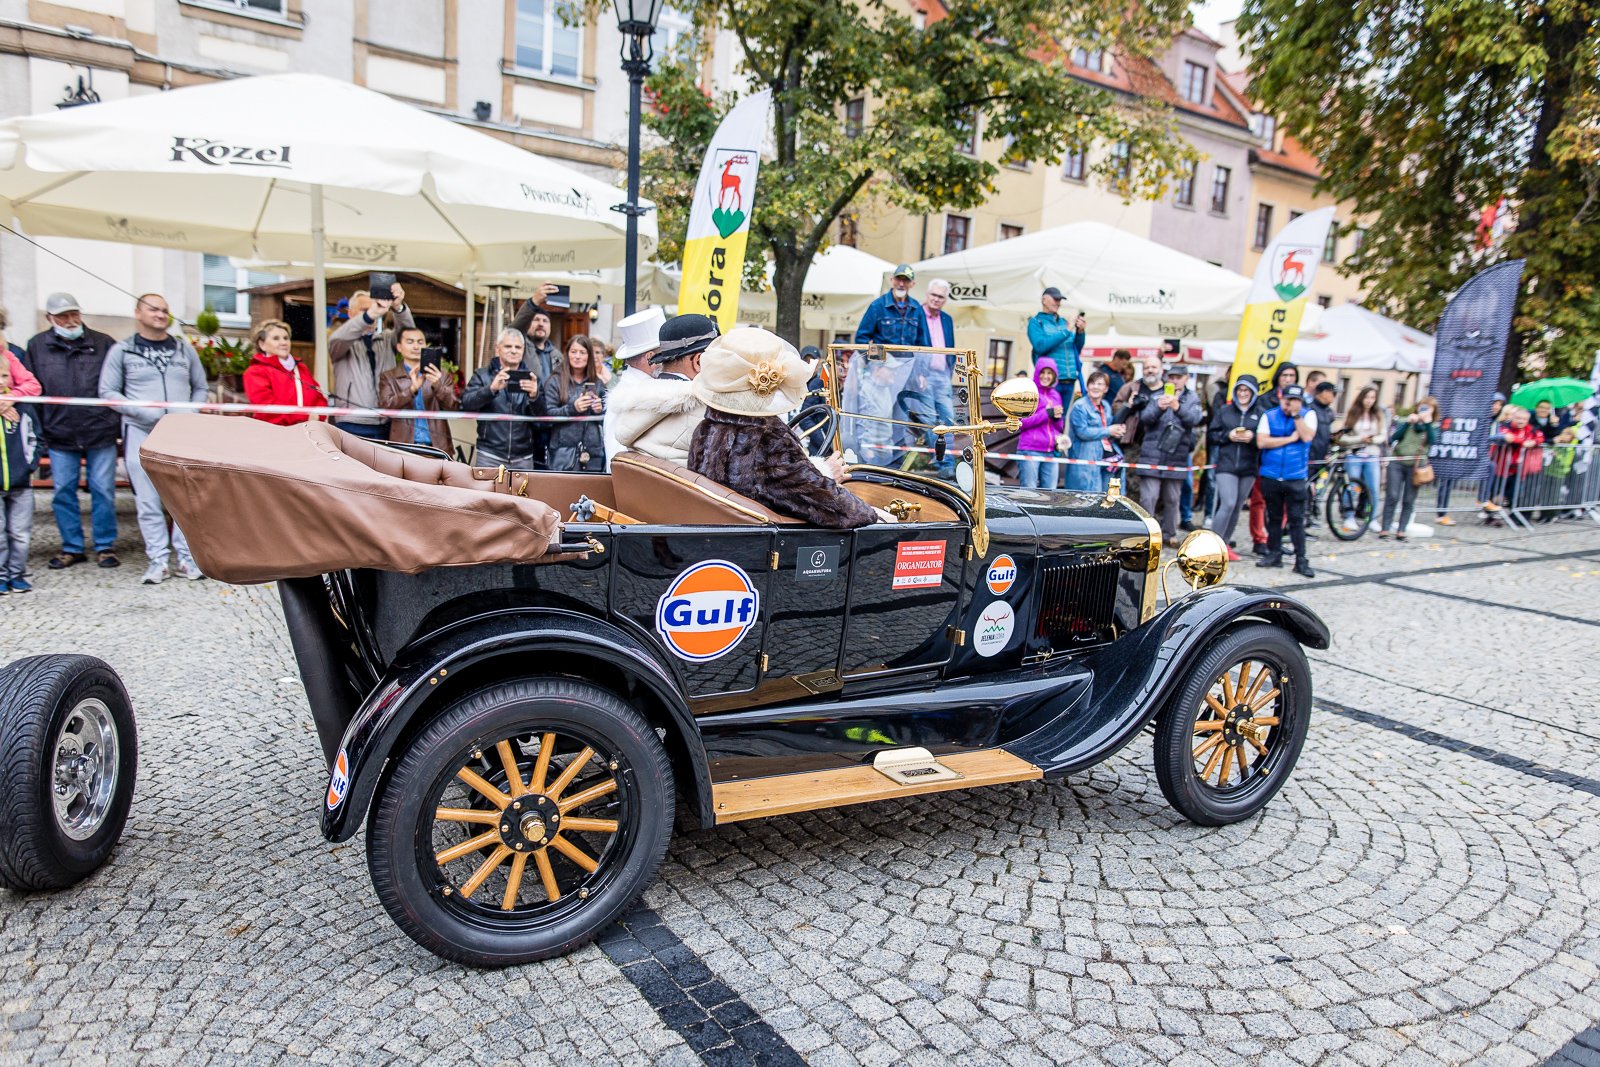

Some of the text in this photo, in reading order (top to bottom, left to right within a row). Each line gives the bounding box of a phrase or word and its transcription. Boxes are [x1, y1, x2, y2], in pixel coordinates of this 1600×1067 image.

[168, 136, 292, 169] Kozel
[702, 247, 727, 323] óra
[1258, 308, 1286, 370] Góra
[897, 560, 943, 570] ORGANIZATOR
[988, 569, 1015, 581] Gulf
[664, 598, 753, 626] Gulf
